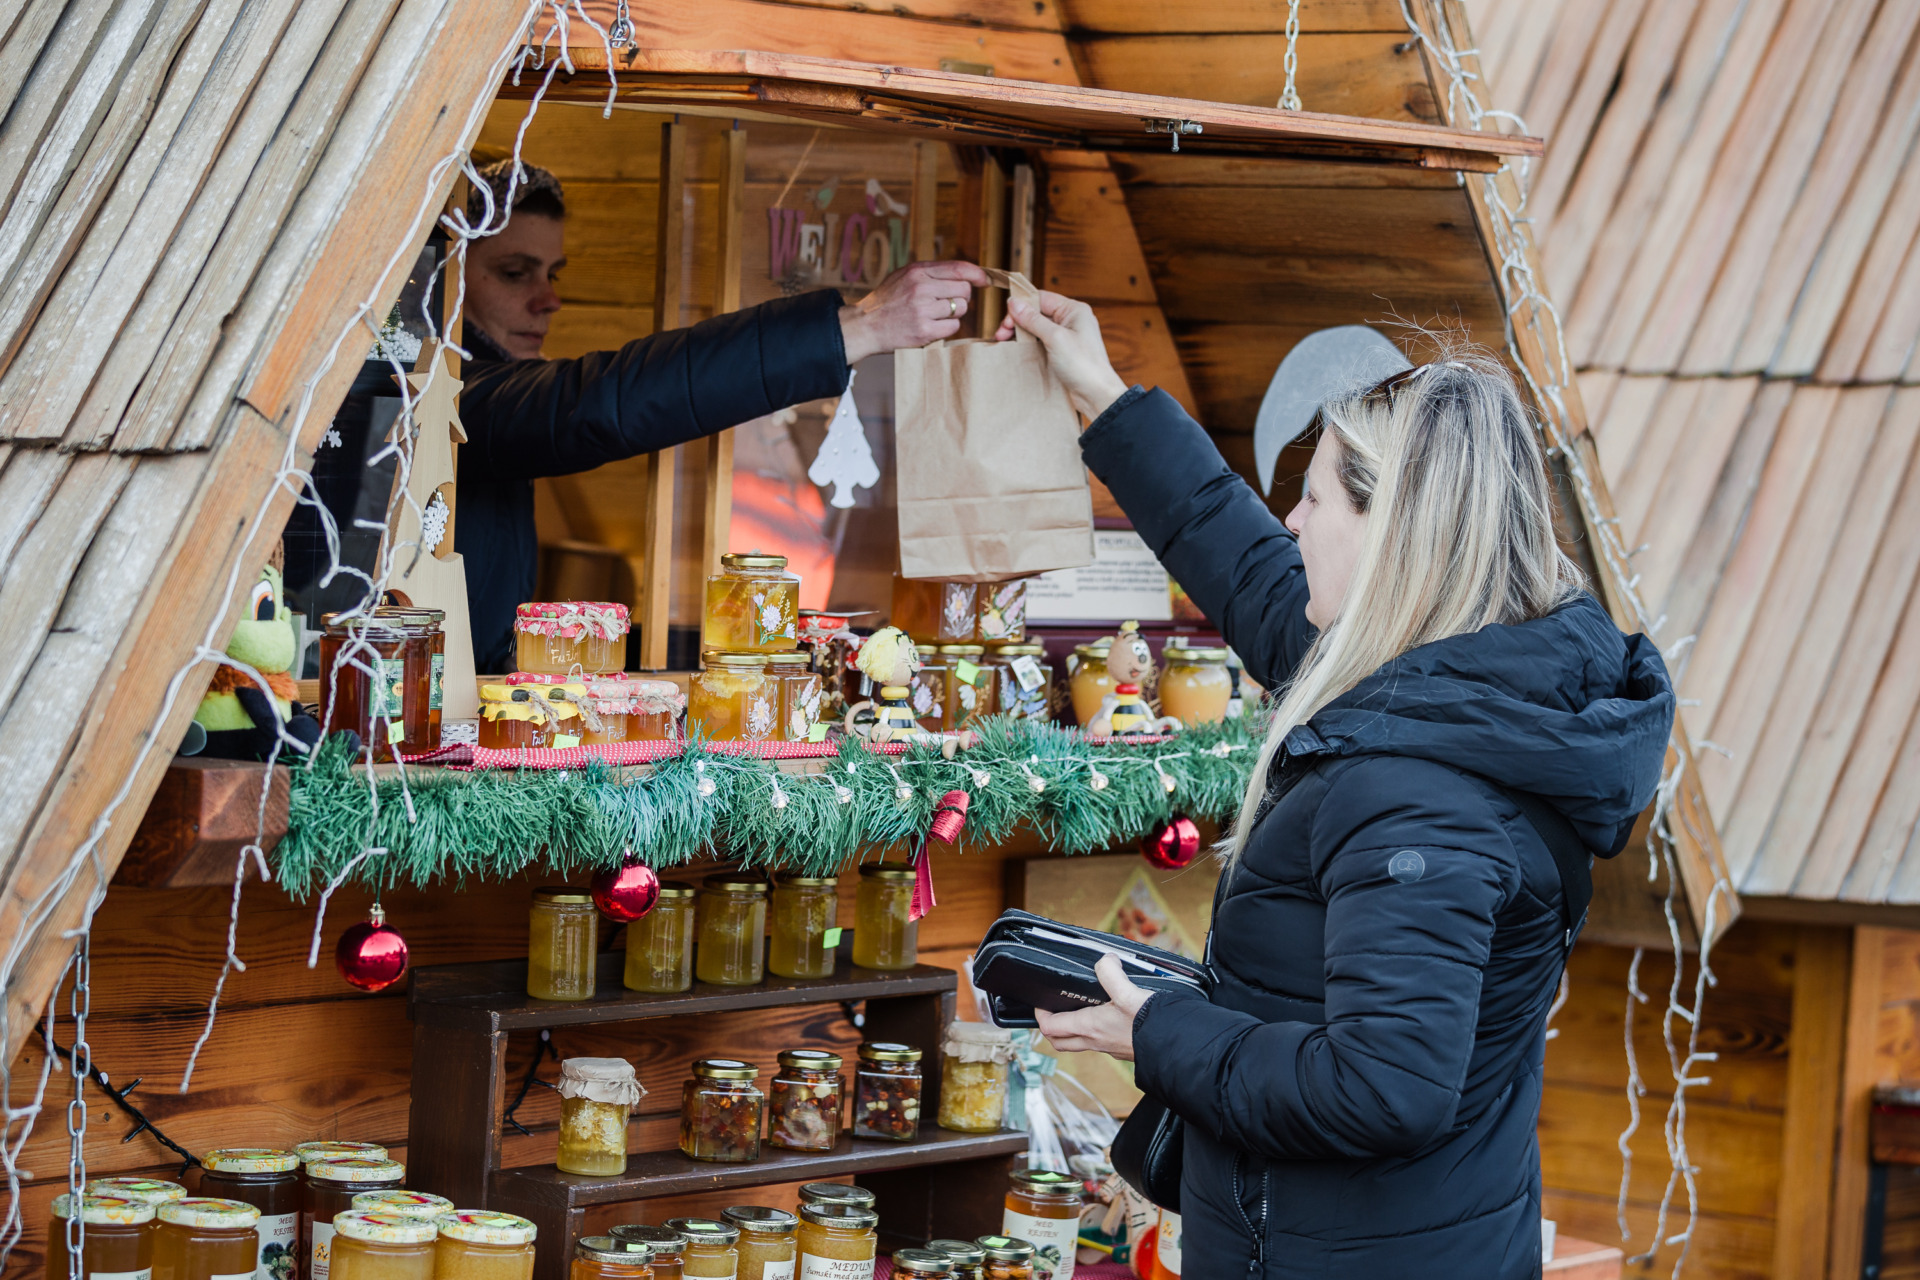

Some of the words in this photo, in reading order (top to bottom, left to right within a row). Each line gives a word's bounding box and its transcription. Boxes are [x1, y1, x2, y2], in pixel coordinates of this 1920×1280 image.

[1060, 990, 1087, 1001] PEPE
[1087, 998, 1105, 1006] JE
[278, 1216, 293, 1226] MED
[1033, 1220, 1055, 1228] MED
[1027, 1228, 1060, 1238] KESTEN
